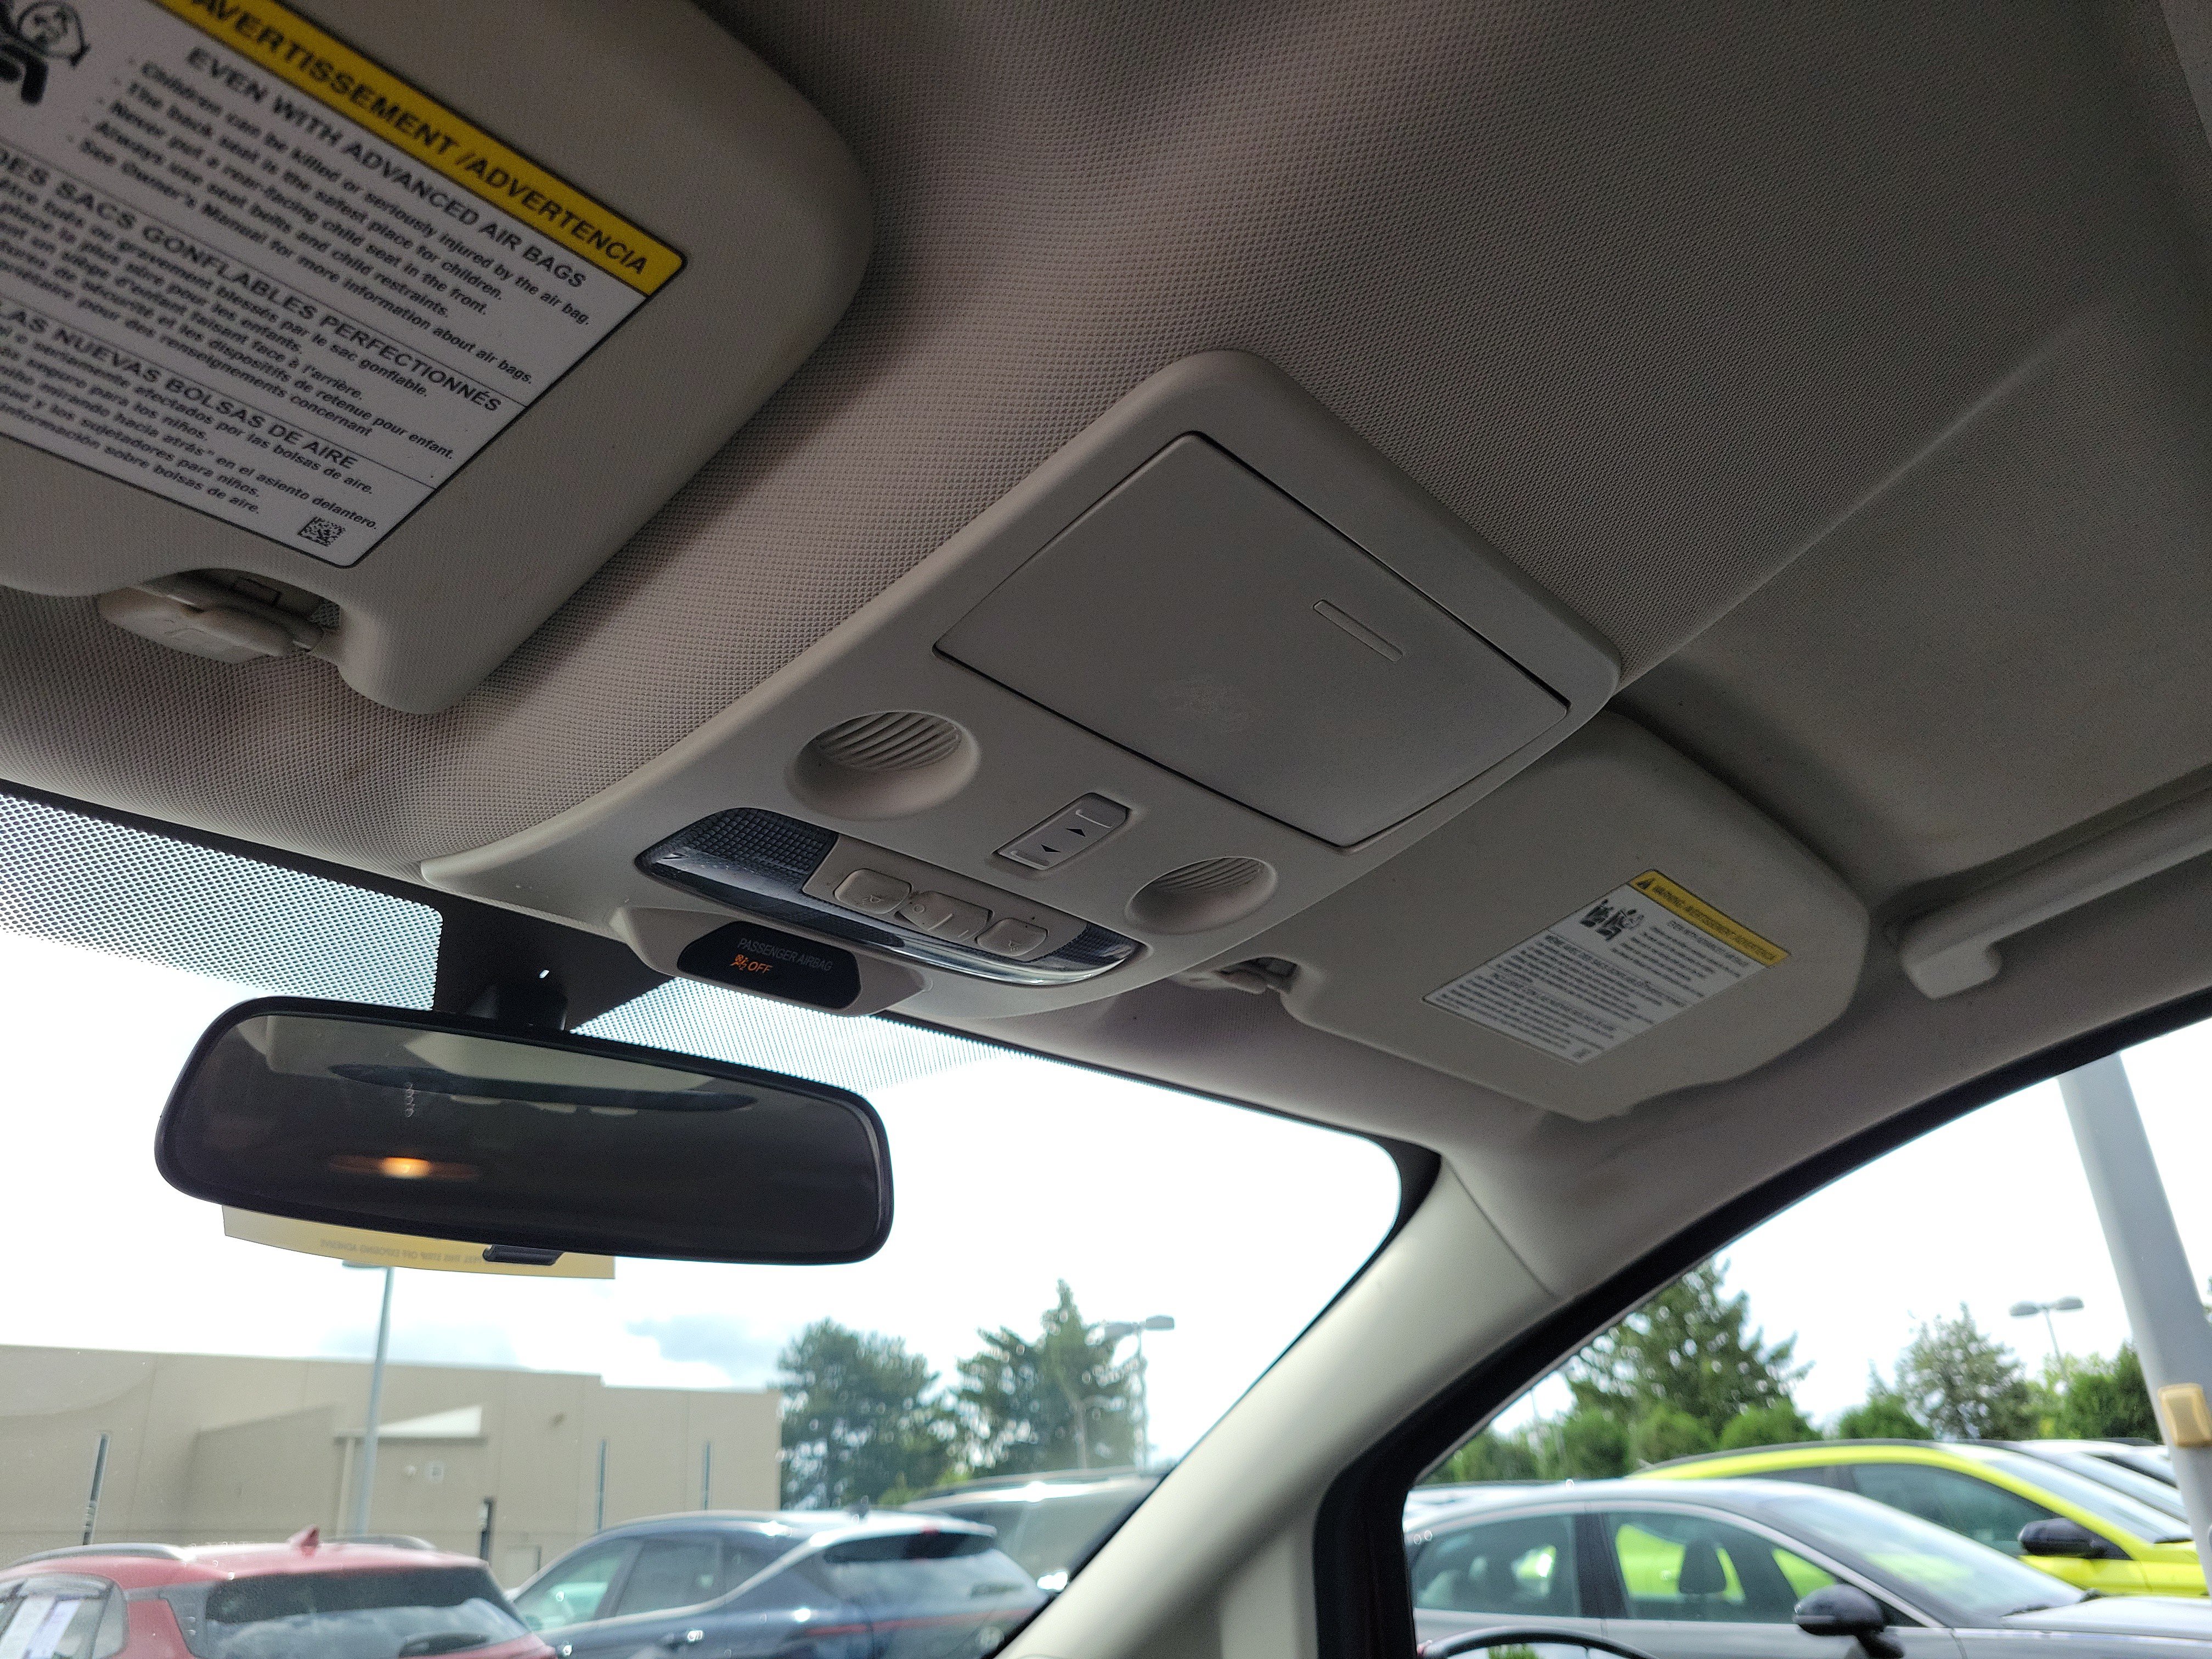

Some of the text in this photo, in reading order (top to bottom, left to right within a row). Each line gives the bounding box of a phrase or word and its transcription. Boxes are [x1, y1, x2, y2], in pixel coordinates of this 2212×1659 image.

[187, 48, 585, 287] EVEN WITH ADVANCED AIR BAGS
[282, 170, 312, 192] the
[314, 190, 368, 223] safest
[367, 221, 413, 249] place
[416, 245, 439, 262] for
[441, 261, 501, 300] children.
[291, 148, 341, 182] killed
[341, 179, 362, 193] or
[364, 192, 437, 238] seriously
[439, 233, 494, 268] injured
[493, 263, 513, 280] by
[514, 276, 538, 295] the
[539, 292, 561, 306] air
[561, 302, 589, 325] bag.
[296, 231, 330, 252] and
[331, 250, 374, 275] child
[374, 273, 447, 315] restraints.
[321, 220, 365, 246] child
[365, 244, 402, 267] seat
[403, 262, 419, 276] in
[421, 273, 447, 291] the
[449, 287, 487, 314] front.
[55, 182, 136, 229] SACS
[142, 225, 317, 319] GONFLABLES
[319, 315, 501, 410] PERFECTIONNÉS
[211, 302, 236, 321] les
[240, 319, 301, 352] enfants.
[216, 286, 278, 322] blessés
[279, 320, 309, 336] par
[312, 333, 326, 346] le
[329, 343, 357, 361] sac
[358, 359, 426, 396] gonflable.
[269, 239, 294, 257] for
[297, 256, 340, 282] more
[342, 278, 430, 329] information
[432, 327, 476, 352] about
[475, 349, 497, 363] air
[497, 359, 531, 383] bags.
[53, 328, 160, 382] NUEVAS
[165, 377, 265, 428] BOLSAS
[267, 424, 302, 444] DE
[302, 441, 357, 469] AIRE
[160, 335, 287, 397] renseignements
[290, 396, 373, 436] concernant
[190, 311, 249, 344] faisant
[251, 340, 285, 362] face
[287, 357, 299, 369] à
[302, 364, 362, 399] l'arrière.
[207, 340, 291, 382] dispositifs
[294, 380, 313, 392] de
[315, 390, 371, 419] retenue
[371, 417, 407, 435] pour
[408, 434, 453, 459] enfant.
[114, 412, 159, 437] hacia
[215, 457, 235, 469] en
[238, 467, 255, 476] el
[256, 474, 309, 499] asiento
[312, 498, 376, 529] delantero.
[134, 386, 213, 424] afectados
[215, 421, 244, 436] por
[246, 433, 270, 448] las
[272, 444, 320, 470] bolsas
[323, 468, 341, 479] de
[343, 477, 371, 494] aire.
[162, 416, 206, 439] niños.
[176, 459, 213, 477] para
[217, 475, 258, 497] niños.
[153, 464, 204, 490] bolsas
[206, 488, 226, 499] de
[228, 496, 258, 514] aire.
[737, 938, 833, 972] PASSENGER AIRBAG
[747, 961, 773, 974] OFF
